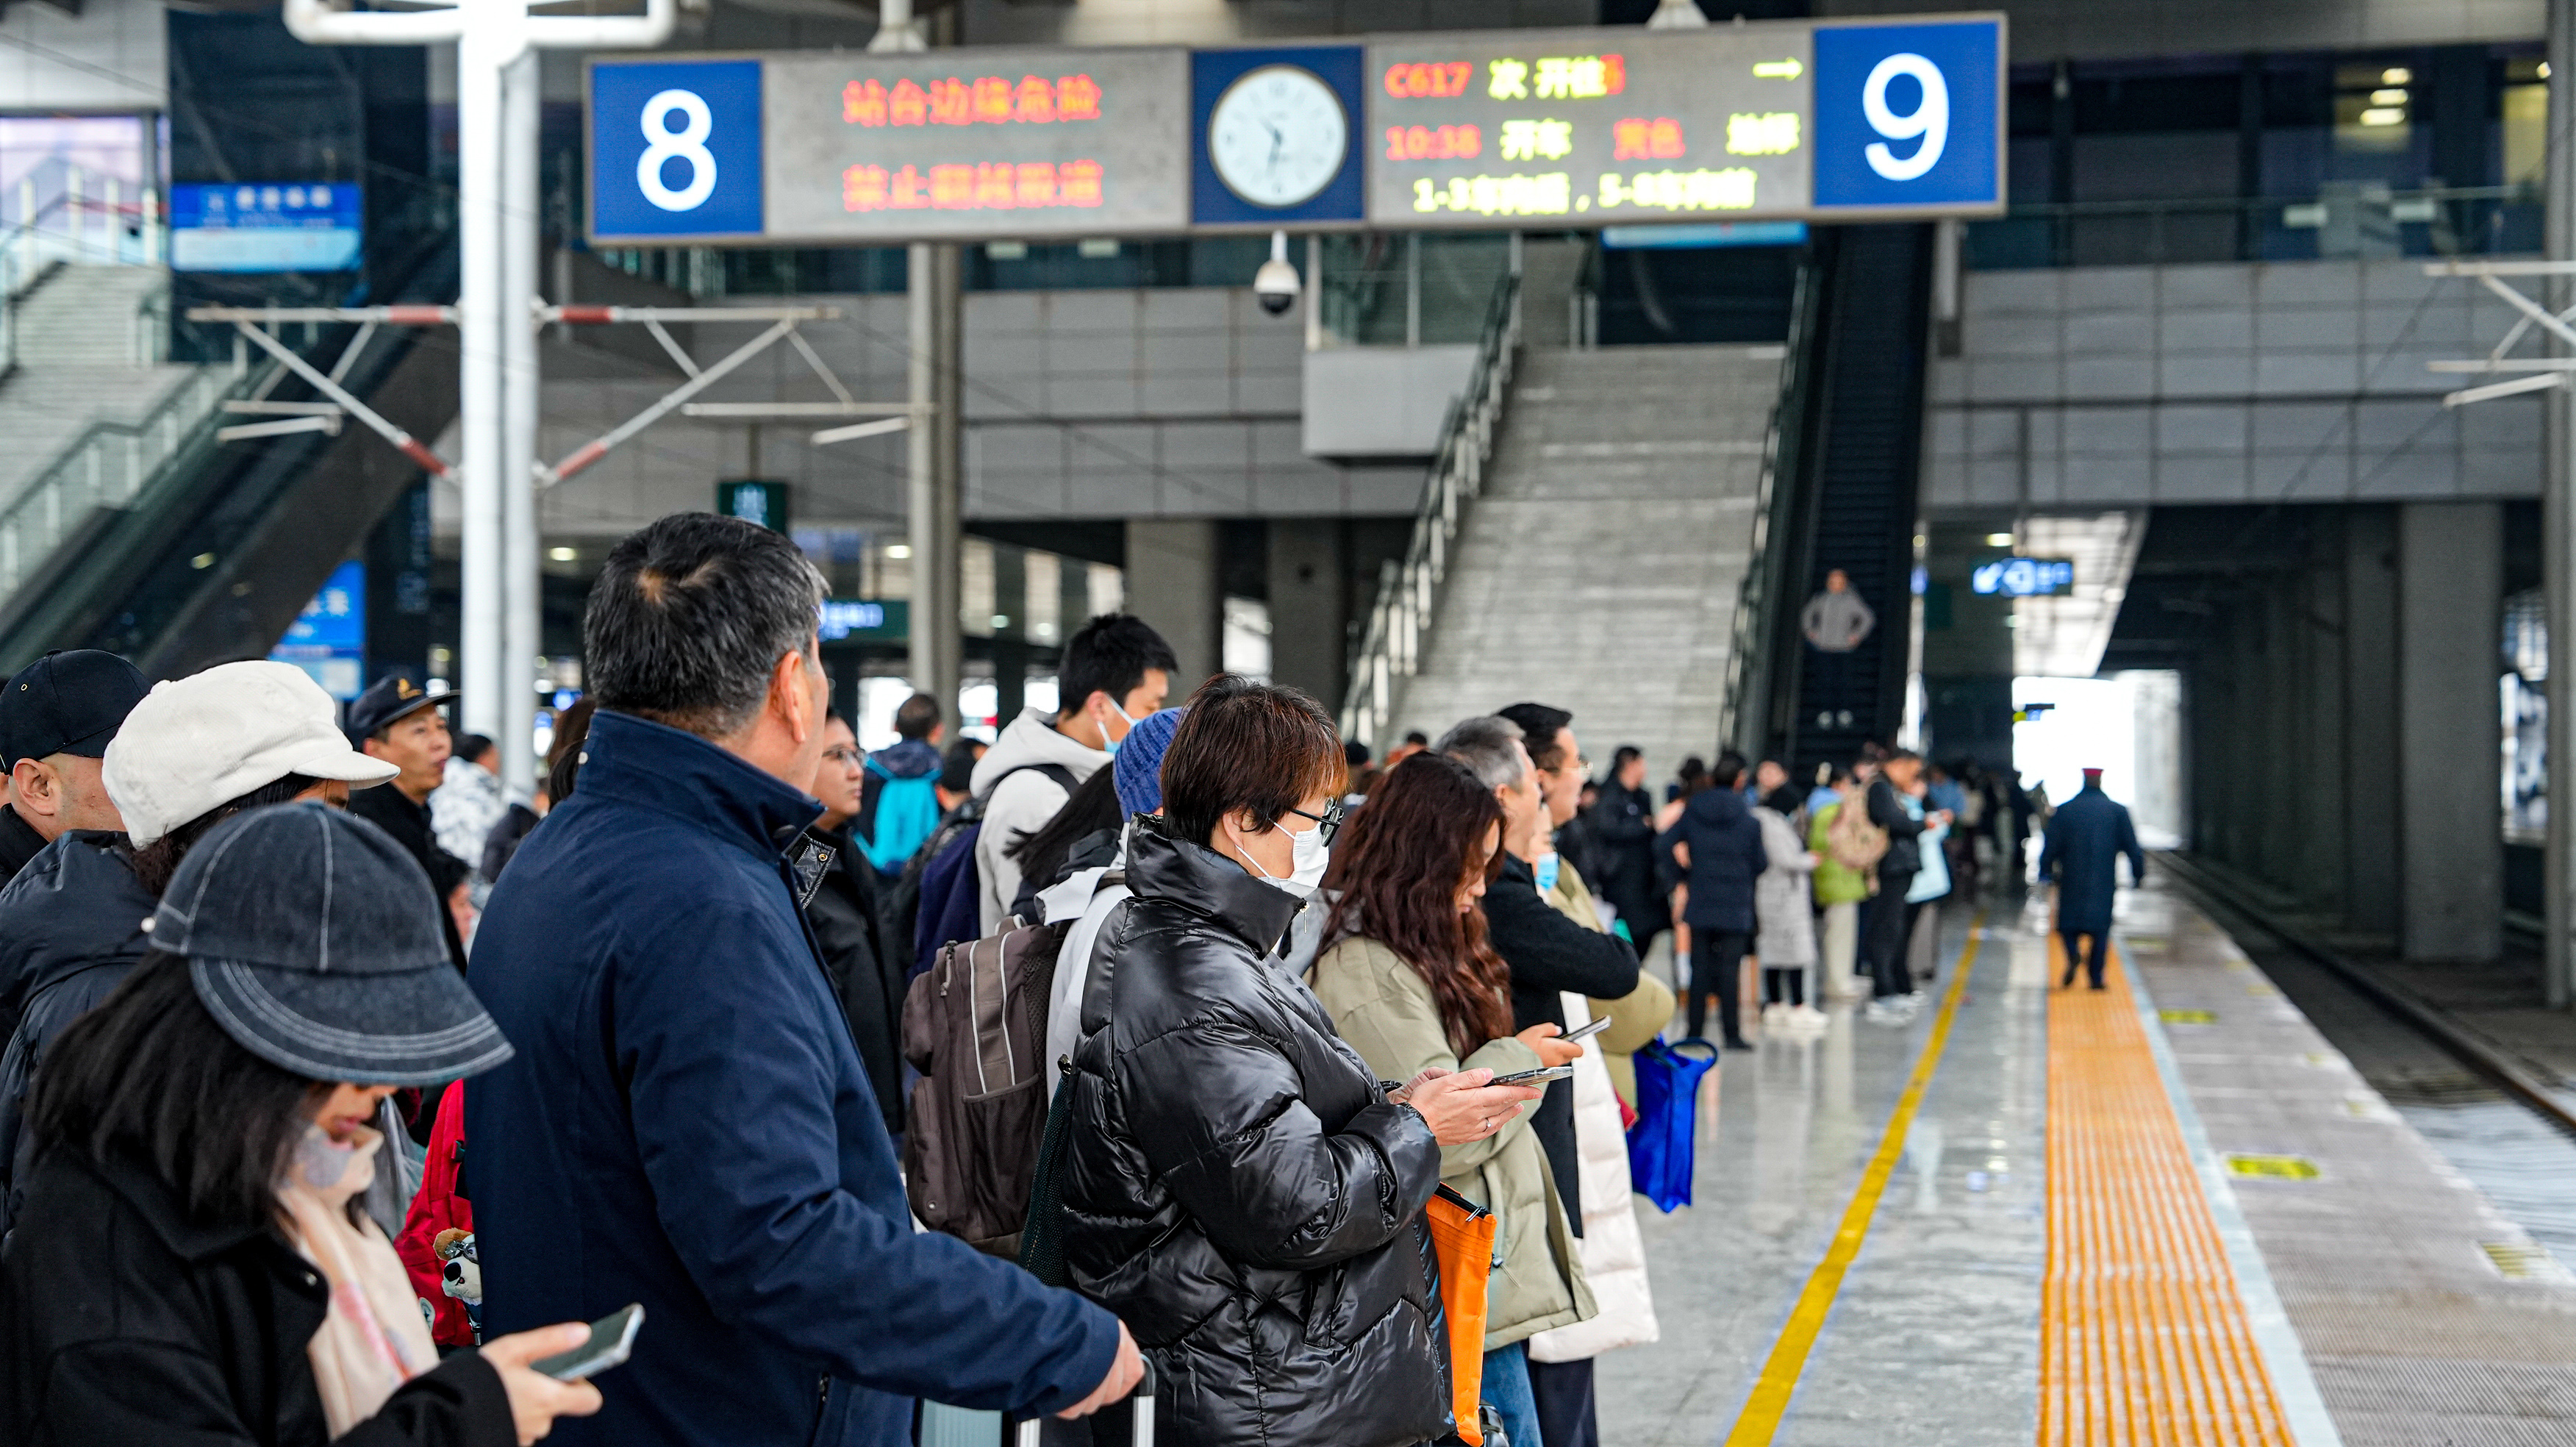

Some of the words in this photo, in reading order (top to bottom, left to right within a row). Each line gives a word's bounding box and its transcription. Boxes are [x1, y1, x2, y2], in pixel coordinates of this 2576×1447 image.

[842, 74, 1102, 126] 站台边缘危险
[1385, 62, 1473, 98] C617
[1488, 57, 1528, 100] 次
[1534, 55, 1607, 99] 开往
[1500, 118, 1573, 162] 开车
[1613, 117, 1685, 160] 黄色
[1862, 53, 1950, 181] 9
[637, 89, 718, 212] 8
